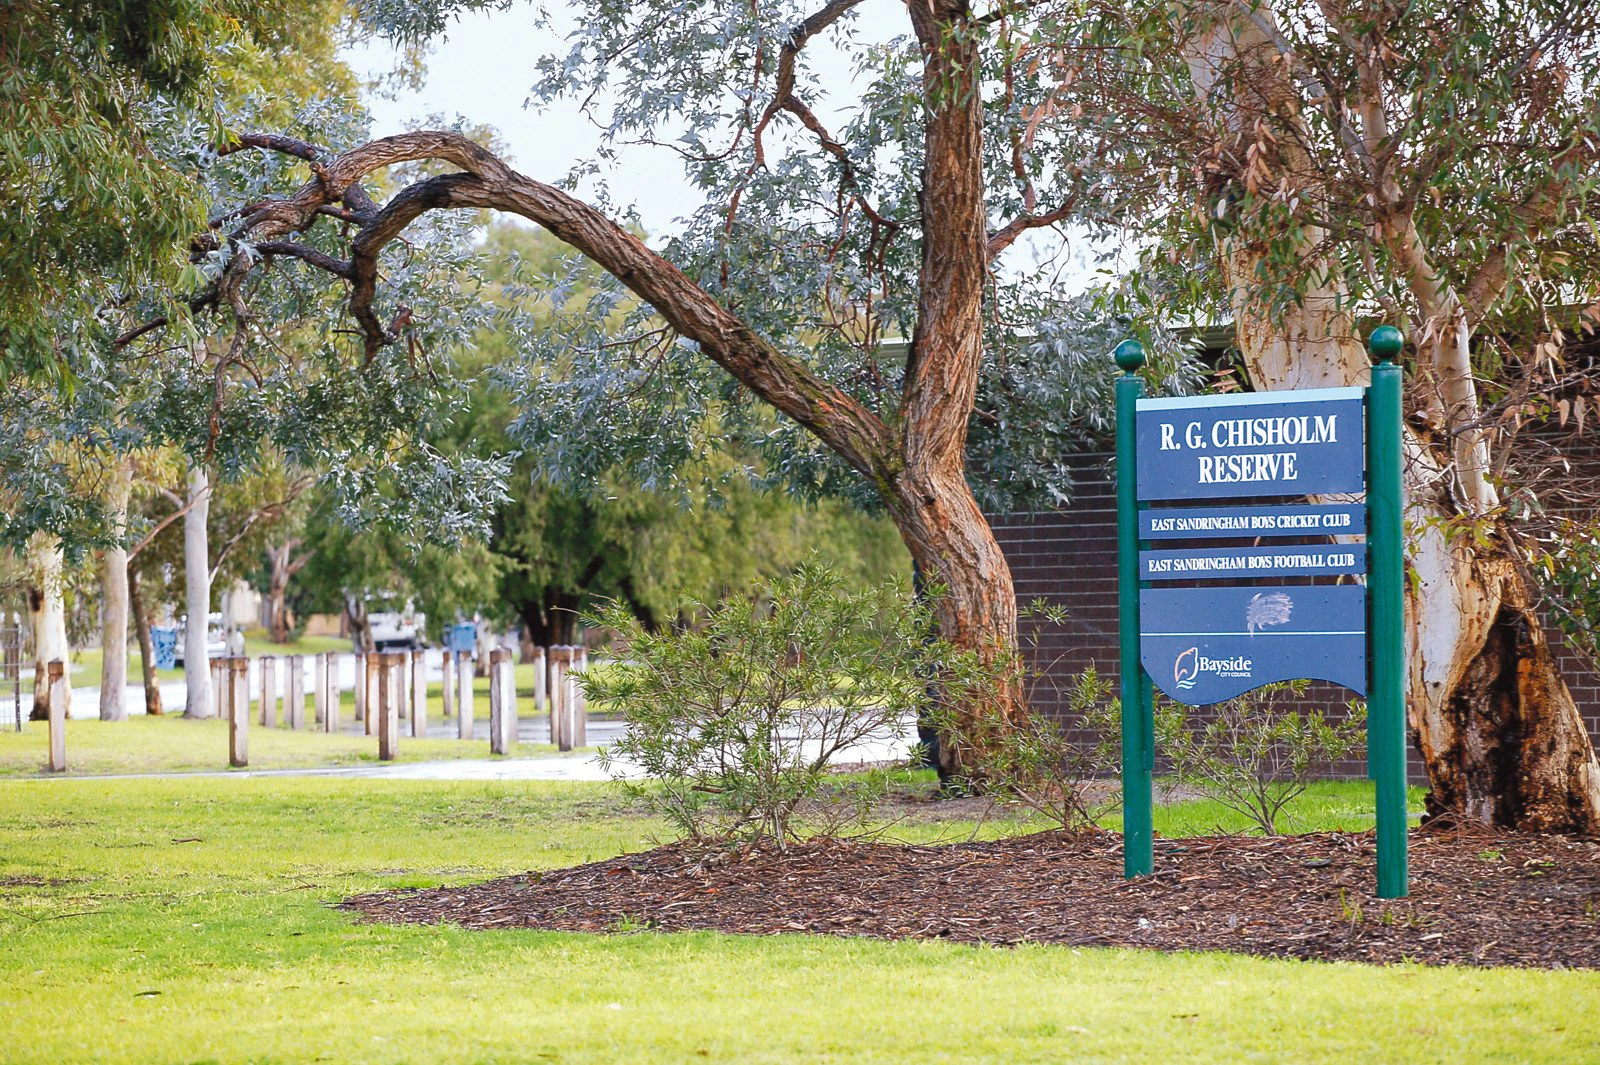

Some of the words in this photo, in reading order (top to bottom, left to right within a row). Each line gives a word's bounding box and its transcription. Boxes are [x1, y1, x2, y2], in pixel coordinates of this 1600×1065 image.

[1160, 423, 1180, 450] R.
[1185, 422, 1206, 449] G.
[1212, 414, 1337, 447] CHISHOLM
[1198, 452, 1298, 484] RESERVE
[1151, 518, 1176, 531] EAST
[1176, 516, 1249, 531] SANDRINGHAM
[1251, 516, 1276, 529] BOYS
[1276, 514, 1320, 528] CRICKET
[1323, 514, 1351, 527] CLUB
[1148, 560, 1172, 572] EAST
[1174, 556, 1246, 572] SANDRINGHAM
[1248, 556, 1272, 570] BOYS
[1274, 554, 1326, 568] FOOTBALL
[1327, 554, 1355, 567] CLUB
[1199, 656, 1252, 675] Bayside
